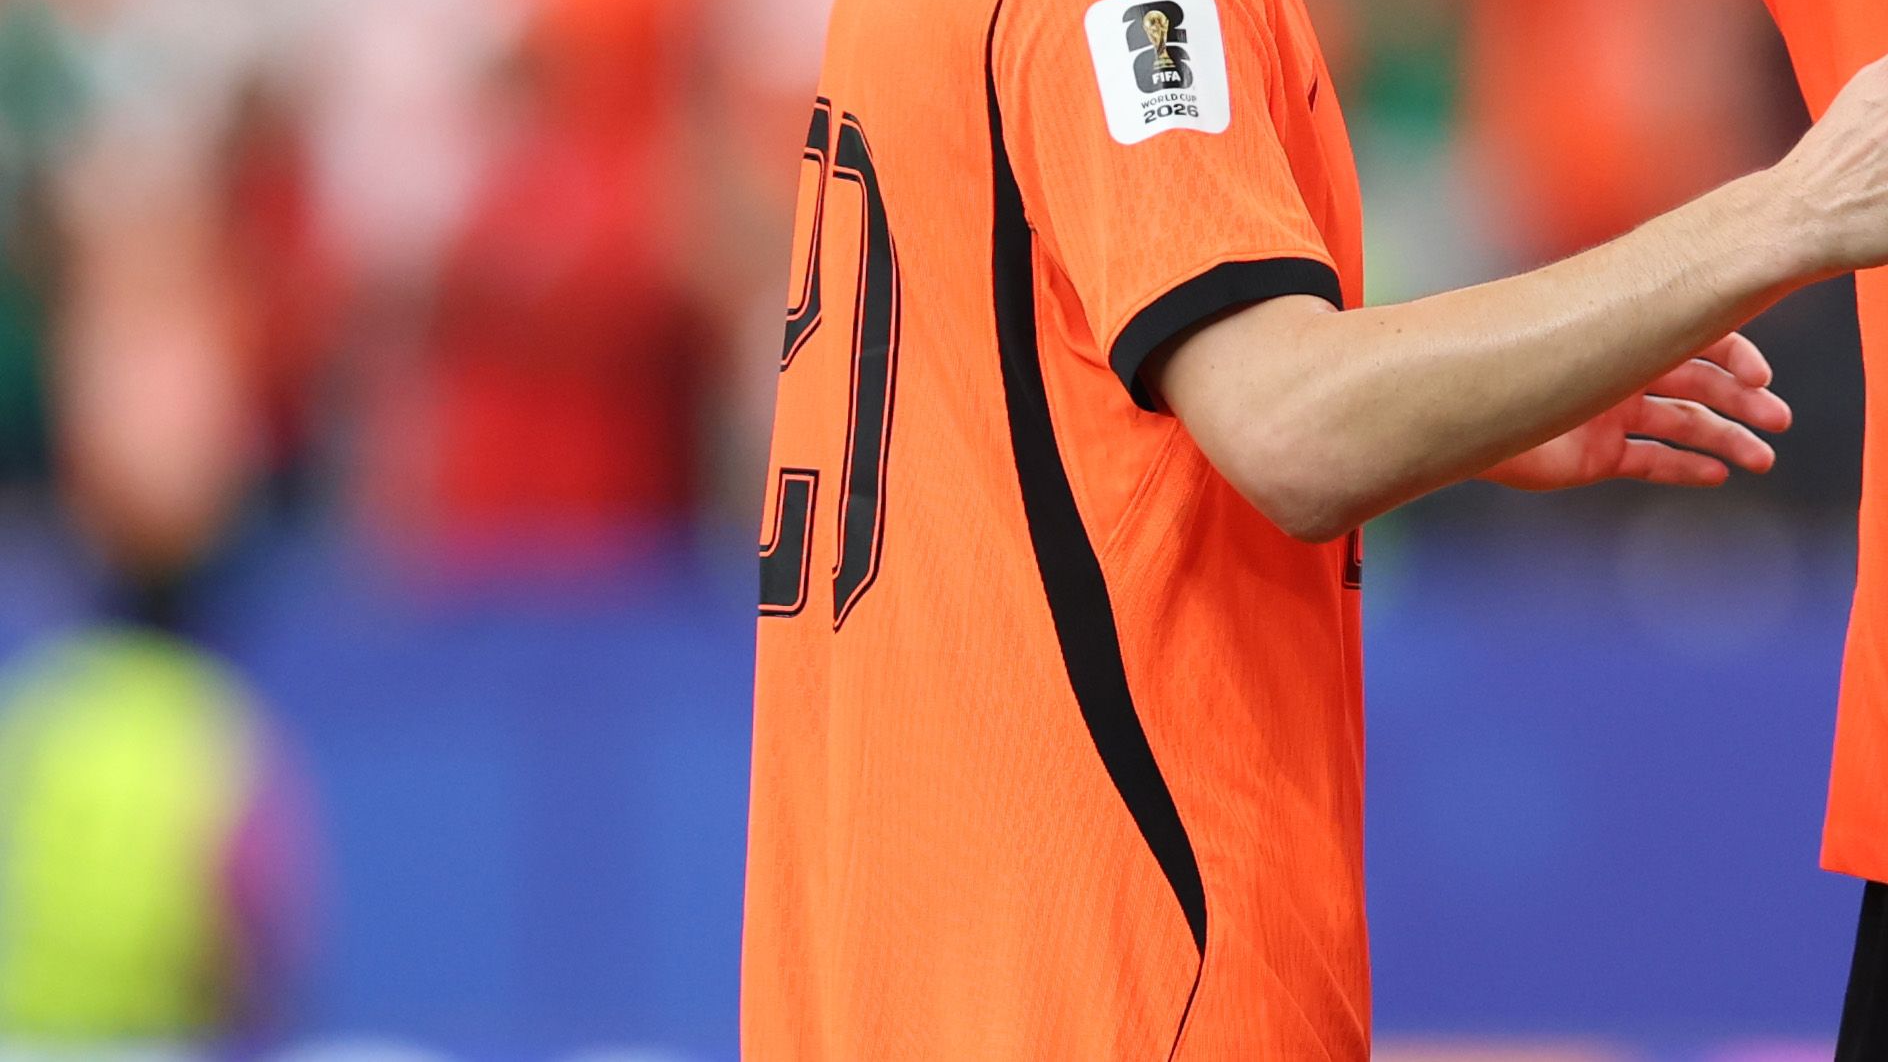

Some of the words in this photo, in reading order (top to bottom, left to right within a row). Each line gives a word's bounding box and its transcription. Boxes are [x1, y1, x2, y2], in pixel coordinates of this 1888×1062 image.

[1152, 71, 1181, 85] FIFA
[1141, 93, 1178, 109] WORLD
[1180, 93, 1197, 102] CUP
[1143, 103, 1199, 125] 2026
